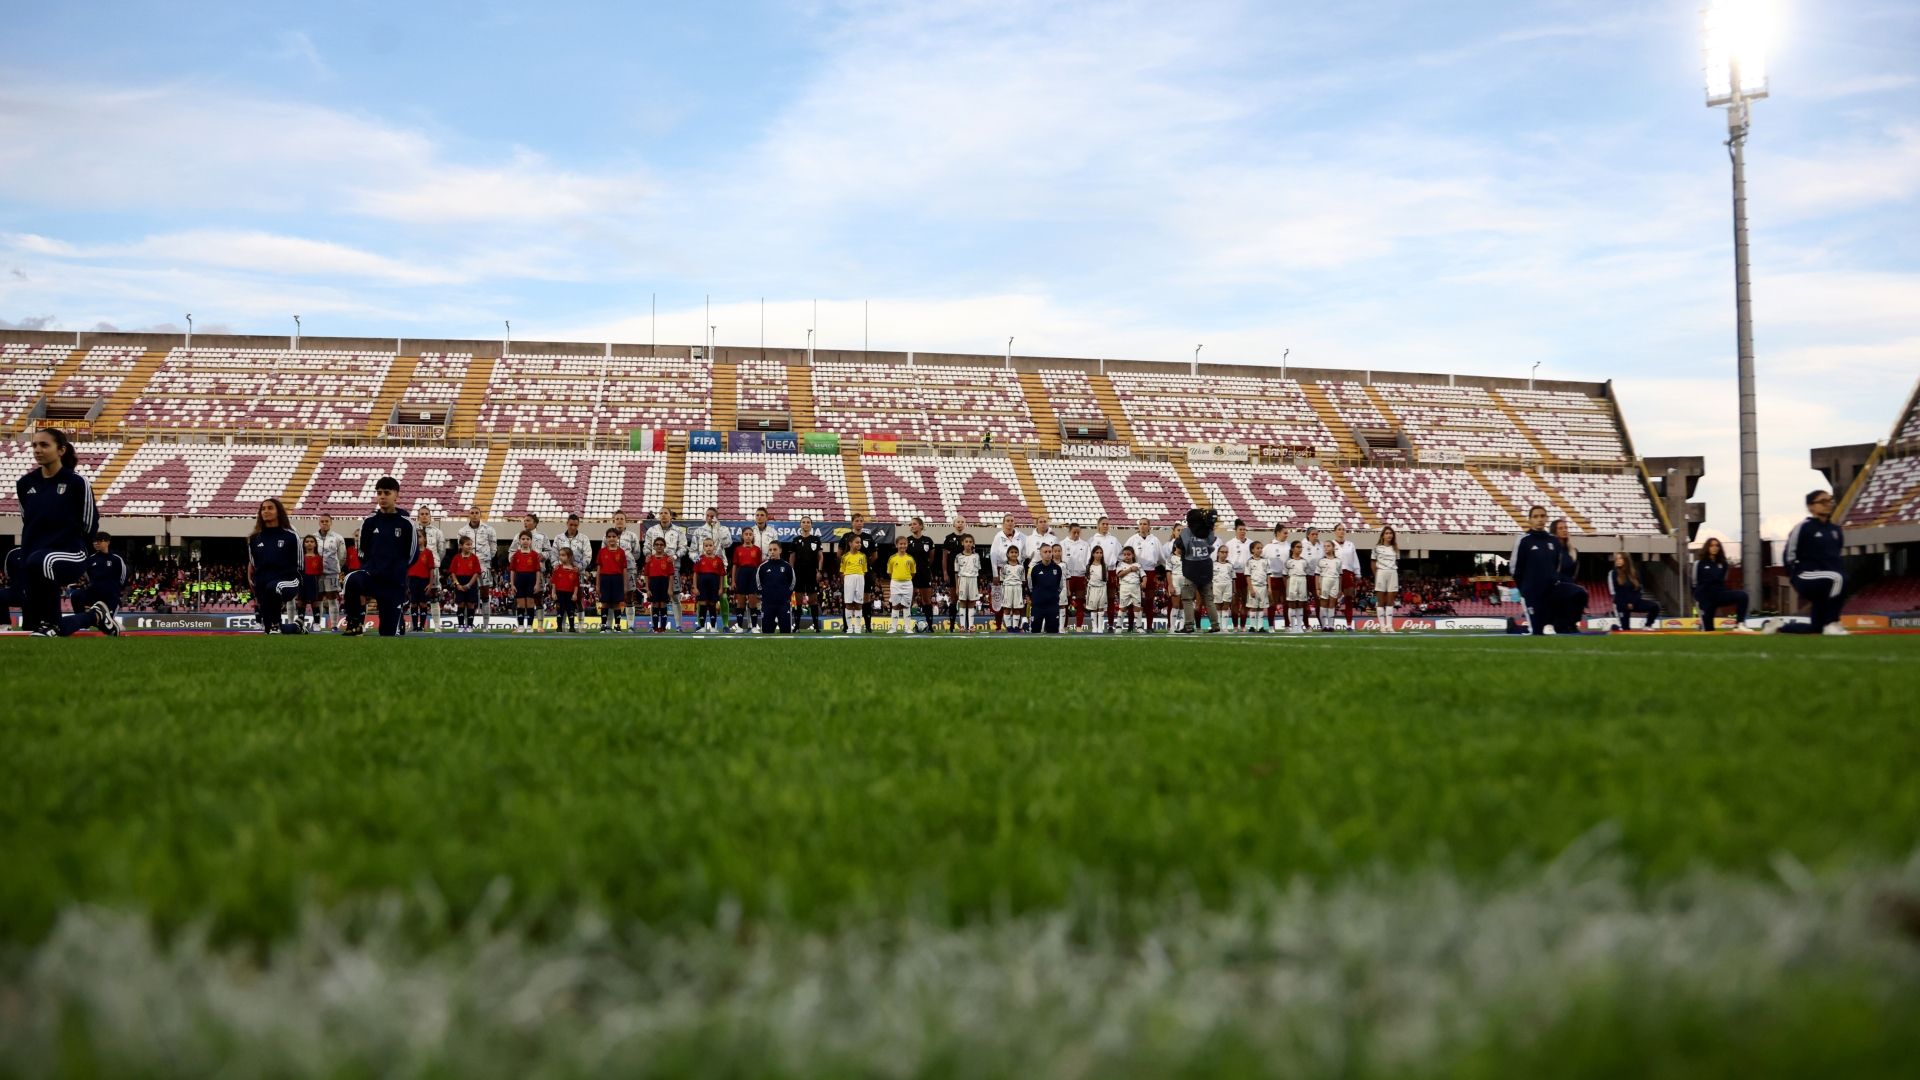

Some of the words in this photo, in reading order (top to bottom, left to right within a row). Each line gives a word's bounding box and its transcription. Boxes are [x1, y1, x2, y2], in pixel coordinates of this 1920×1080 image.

[694, 437, 716, 446] FIFA
[767, 441, 796, 450] UEFA
[1061, 444, 1130, 457] BARONISSI
[1192, 546, 1208, 557] 123
[155, 619, 212, 629] TeamSystem
